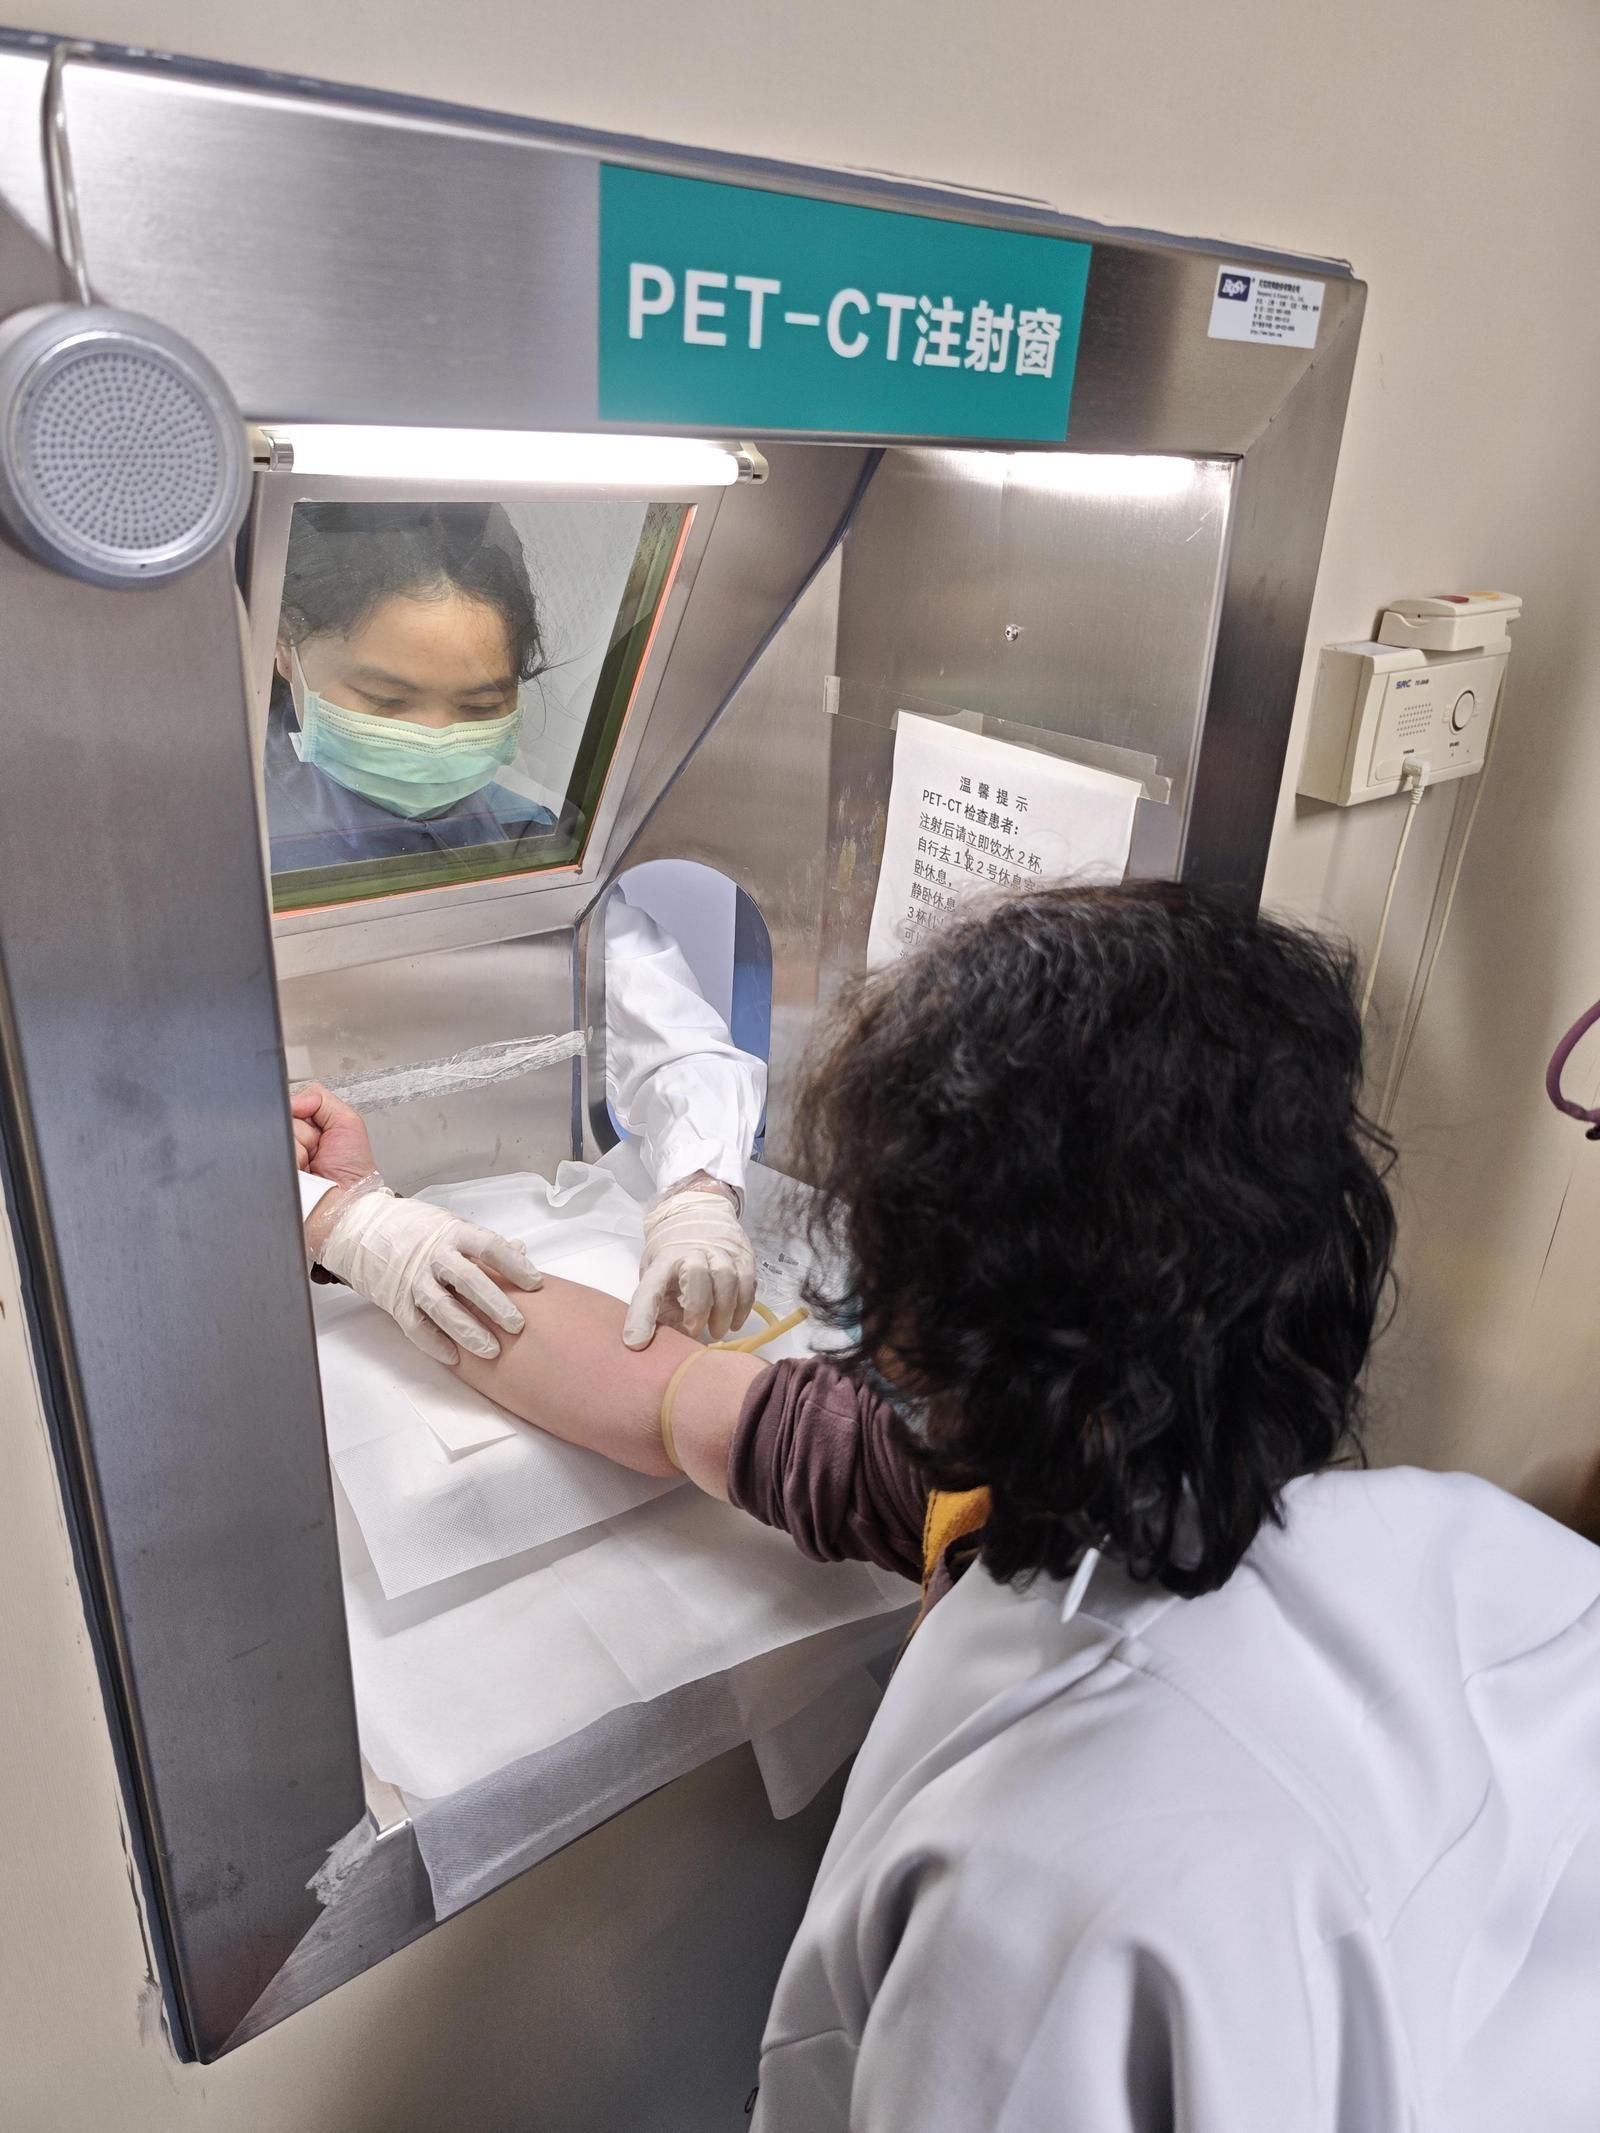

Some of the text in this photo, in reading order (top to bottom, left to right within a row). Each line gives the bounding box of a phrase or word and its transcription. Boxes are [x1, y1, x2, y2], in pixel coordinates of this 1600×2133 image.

[628, 262, 1061, 378] PET-CT注射窗
[960, 776, 1028, 813] 温馨提示
